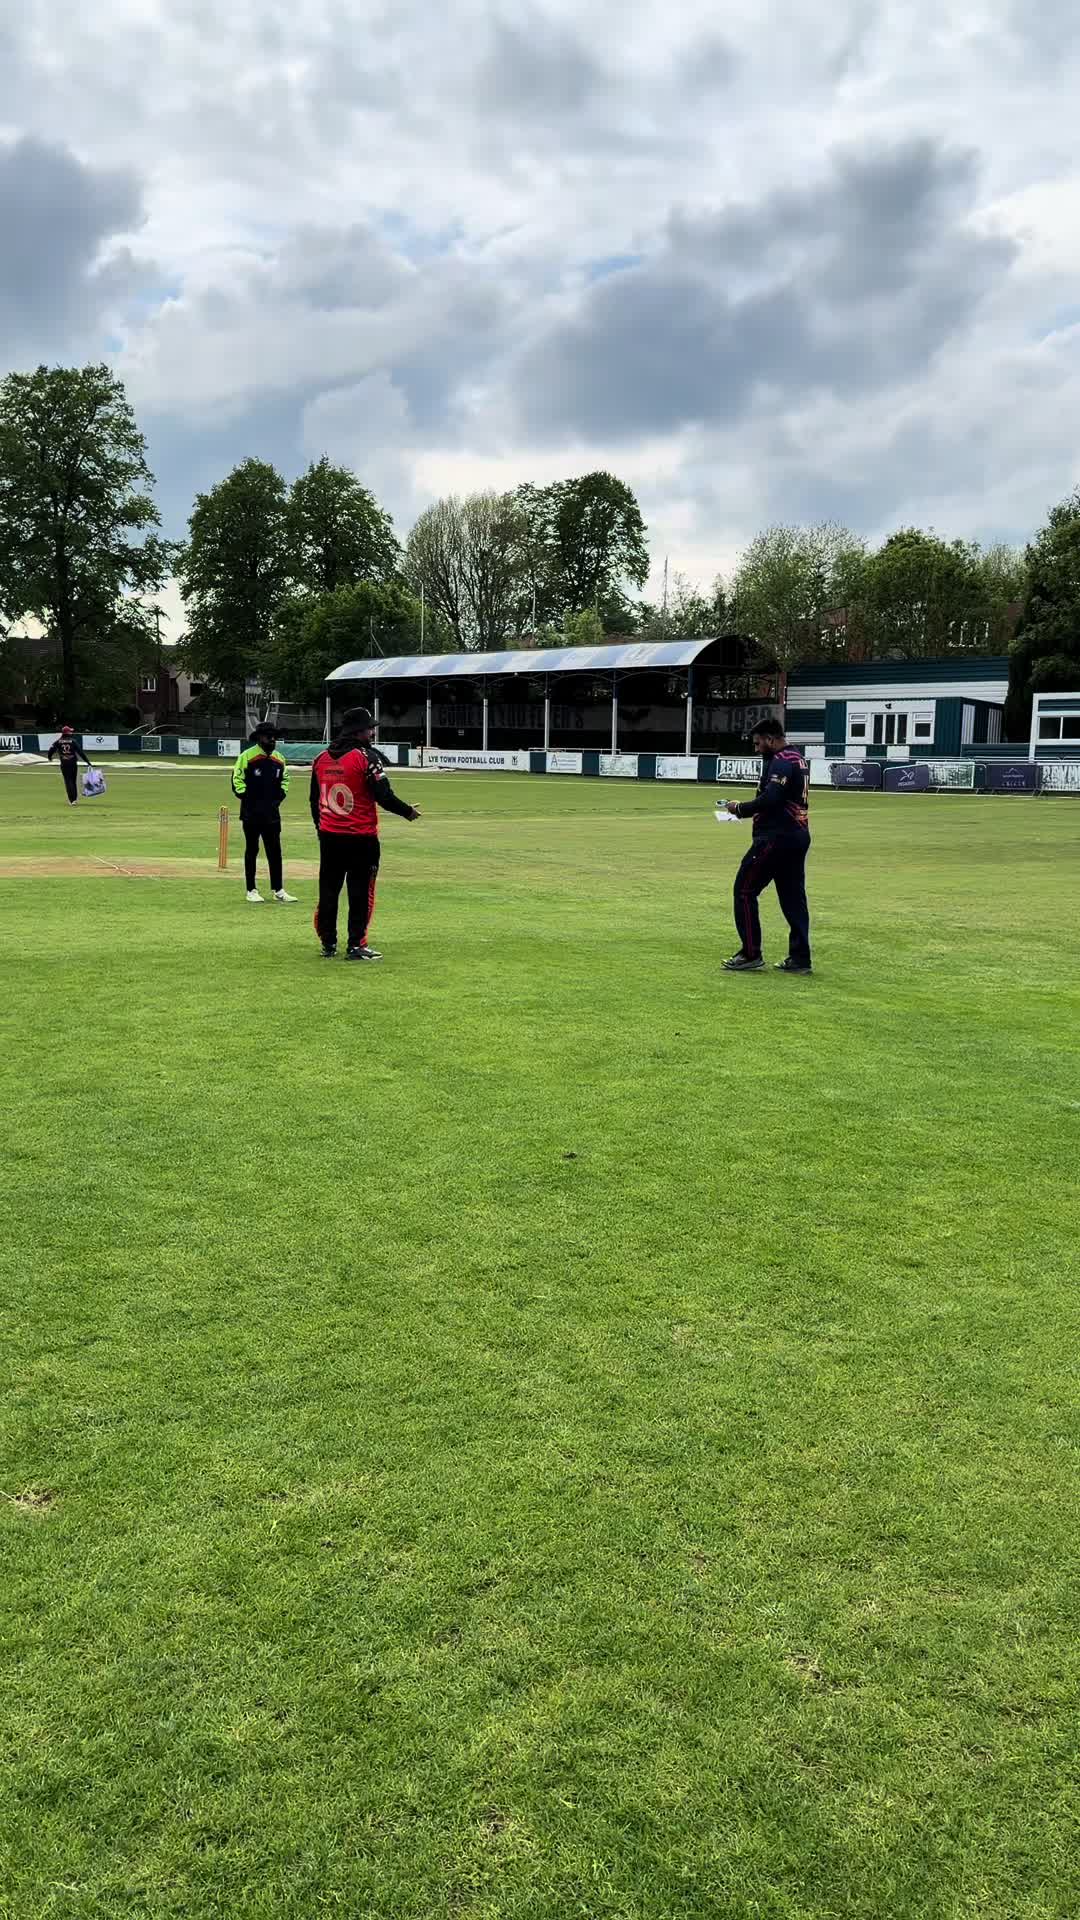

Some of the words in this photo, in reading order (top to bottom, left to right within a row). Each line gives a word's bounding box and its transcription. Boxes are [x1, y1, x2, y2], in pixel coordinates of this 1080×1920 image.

[0, 736, 20, 747] IVAL
[457, 756, 487, 764] FOOTBALL
[488, 757, 505, 765] CLUB
[720, 760, 759, 775] REVIVAL
